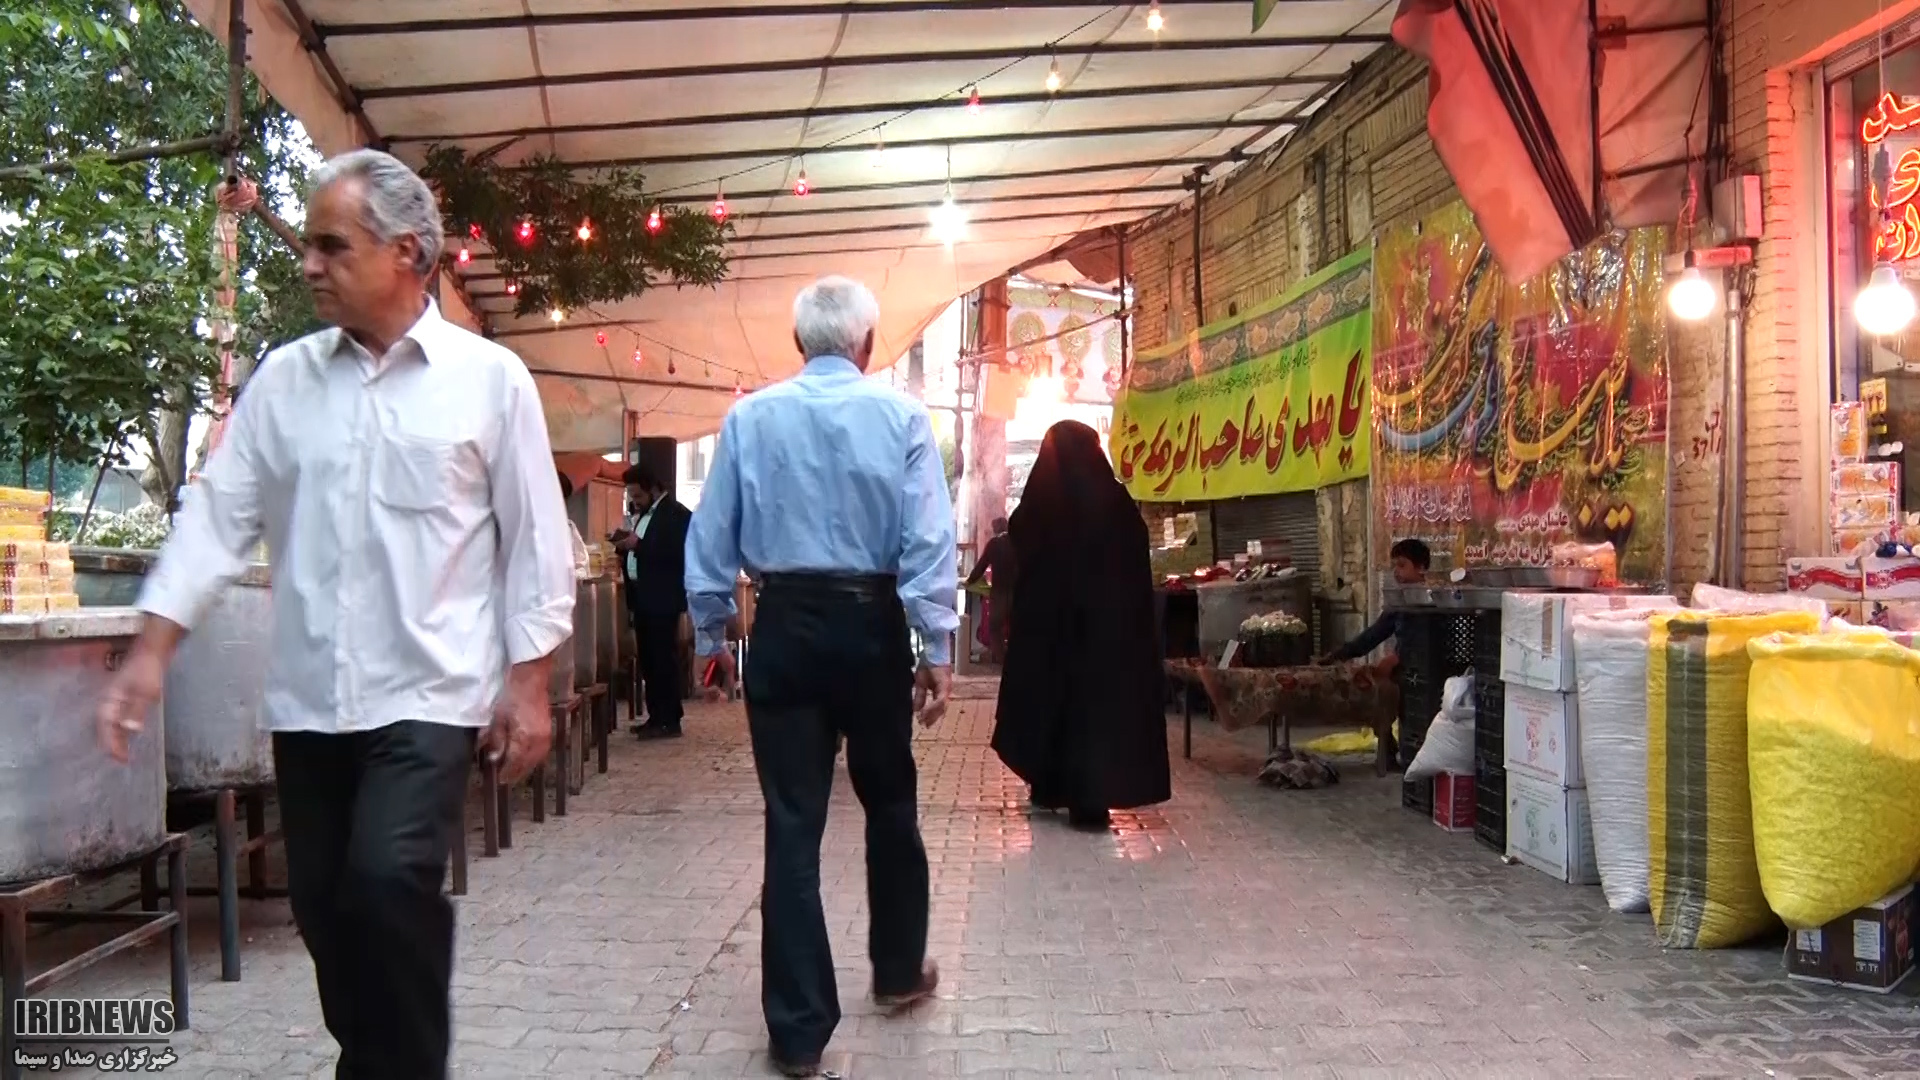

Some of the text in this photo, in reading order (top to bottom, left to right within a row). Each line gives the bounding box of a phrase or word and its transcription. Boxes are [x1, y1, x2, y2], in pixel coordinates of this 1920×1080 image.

[1199, 394, 1265, 494] صاحب
[1265, 390, 1335, 474] مهدی
[1338, 348, 1366, 471] یا
